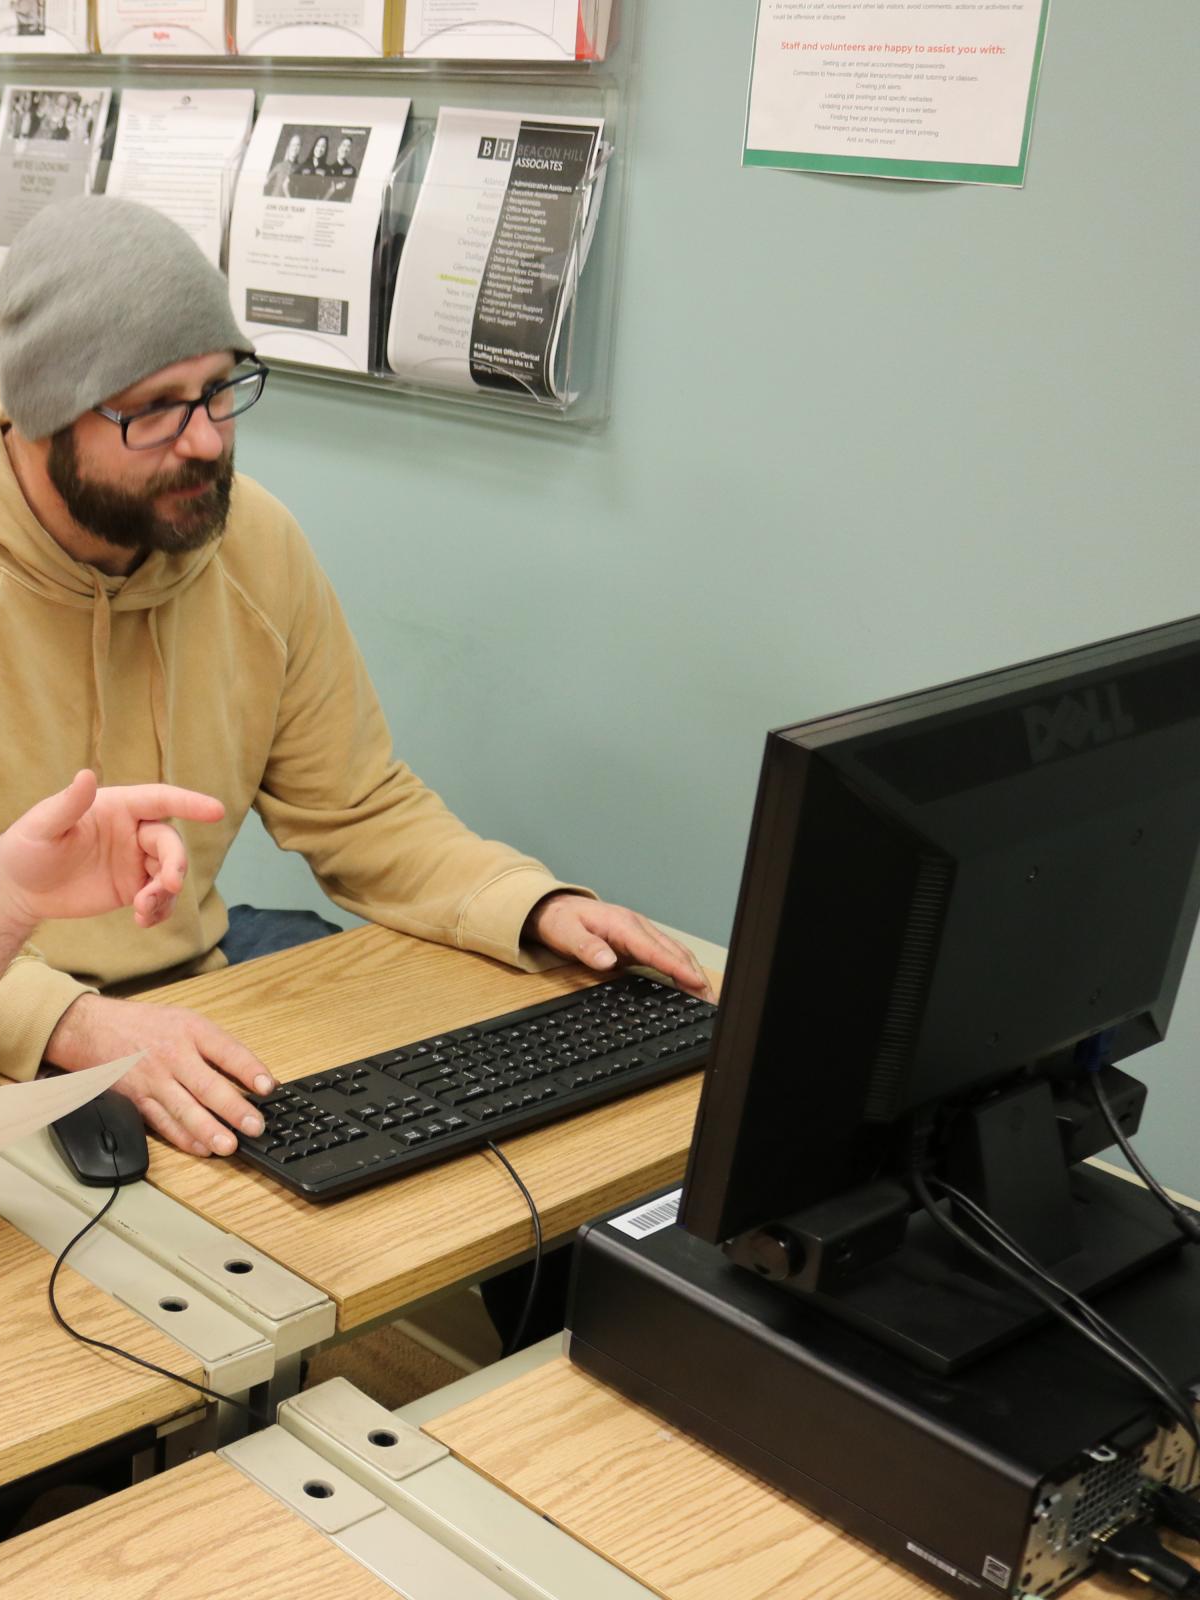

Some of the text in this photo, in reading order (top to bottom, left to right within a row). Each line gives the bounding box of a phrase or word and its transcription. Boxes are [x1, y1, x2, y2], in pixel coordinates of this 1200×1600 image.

[781, 42, 800, 50] Staff
[802, 42, 818, 50] and
[820, 43, 866, 51] volunteers
[884, 44, 912, 54] happy
[927, 44, 956, 53] assist
[958, 46, 977, 55] you
[980, 45, 1006, 54] with:
[856, 82, 877, 90] Creating
[824, 92, 846, 100] Locating
[856, 94, 876, 102] postings
[830, 114, 848, 122] Finding
[918, 129, 940, 137] printing
[517, 144, 584, 162] BEACON HILL
[515, 157, 563, 172] ASSOCIATES
[514, 180, 572, 192] Administrative Assistants
[506, 206, 546, 217] Office Managers
[506, 214, 547, 226] Customer Service
[514, 233, 545, 244] Coordinators
[522, 242, 554, 253] Coordinators
[514, 250, 535, 259] Support
[493, 256, 546, 270] Data Entry Specialists
[491, 264, 559, 281] Office Services Coordinators
[440, 274, 478, 286] Minneapolis
[513, 276, 534, 286] Support
[487, 280, 533, 294] Marketing Support
[493, 290, 512, 300] Support
[482, 297, 543, 314] Corporate Event Support
[479, 313, 516, 328] Project Support
[482, 305, 495, 314] Small
[502, 310, 516, 319] Large
[516, 312, 544, 325] Temporary
[474, 350, 493, 362] Staffing
[494, 354, 508, 364] Firms
[514, 359, 524, 367] the
[484, 344, 502, 354] Largest
[503, 348, 540, 362] Office/Clerical
[1020, 681, 1136, 764] DELL
